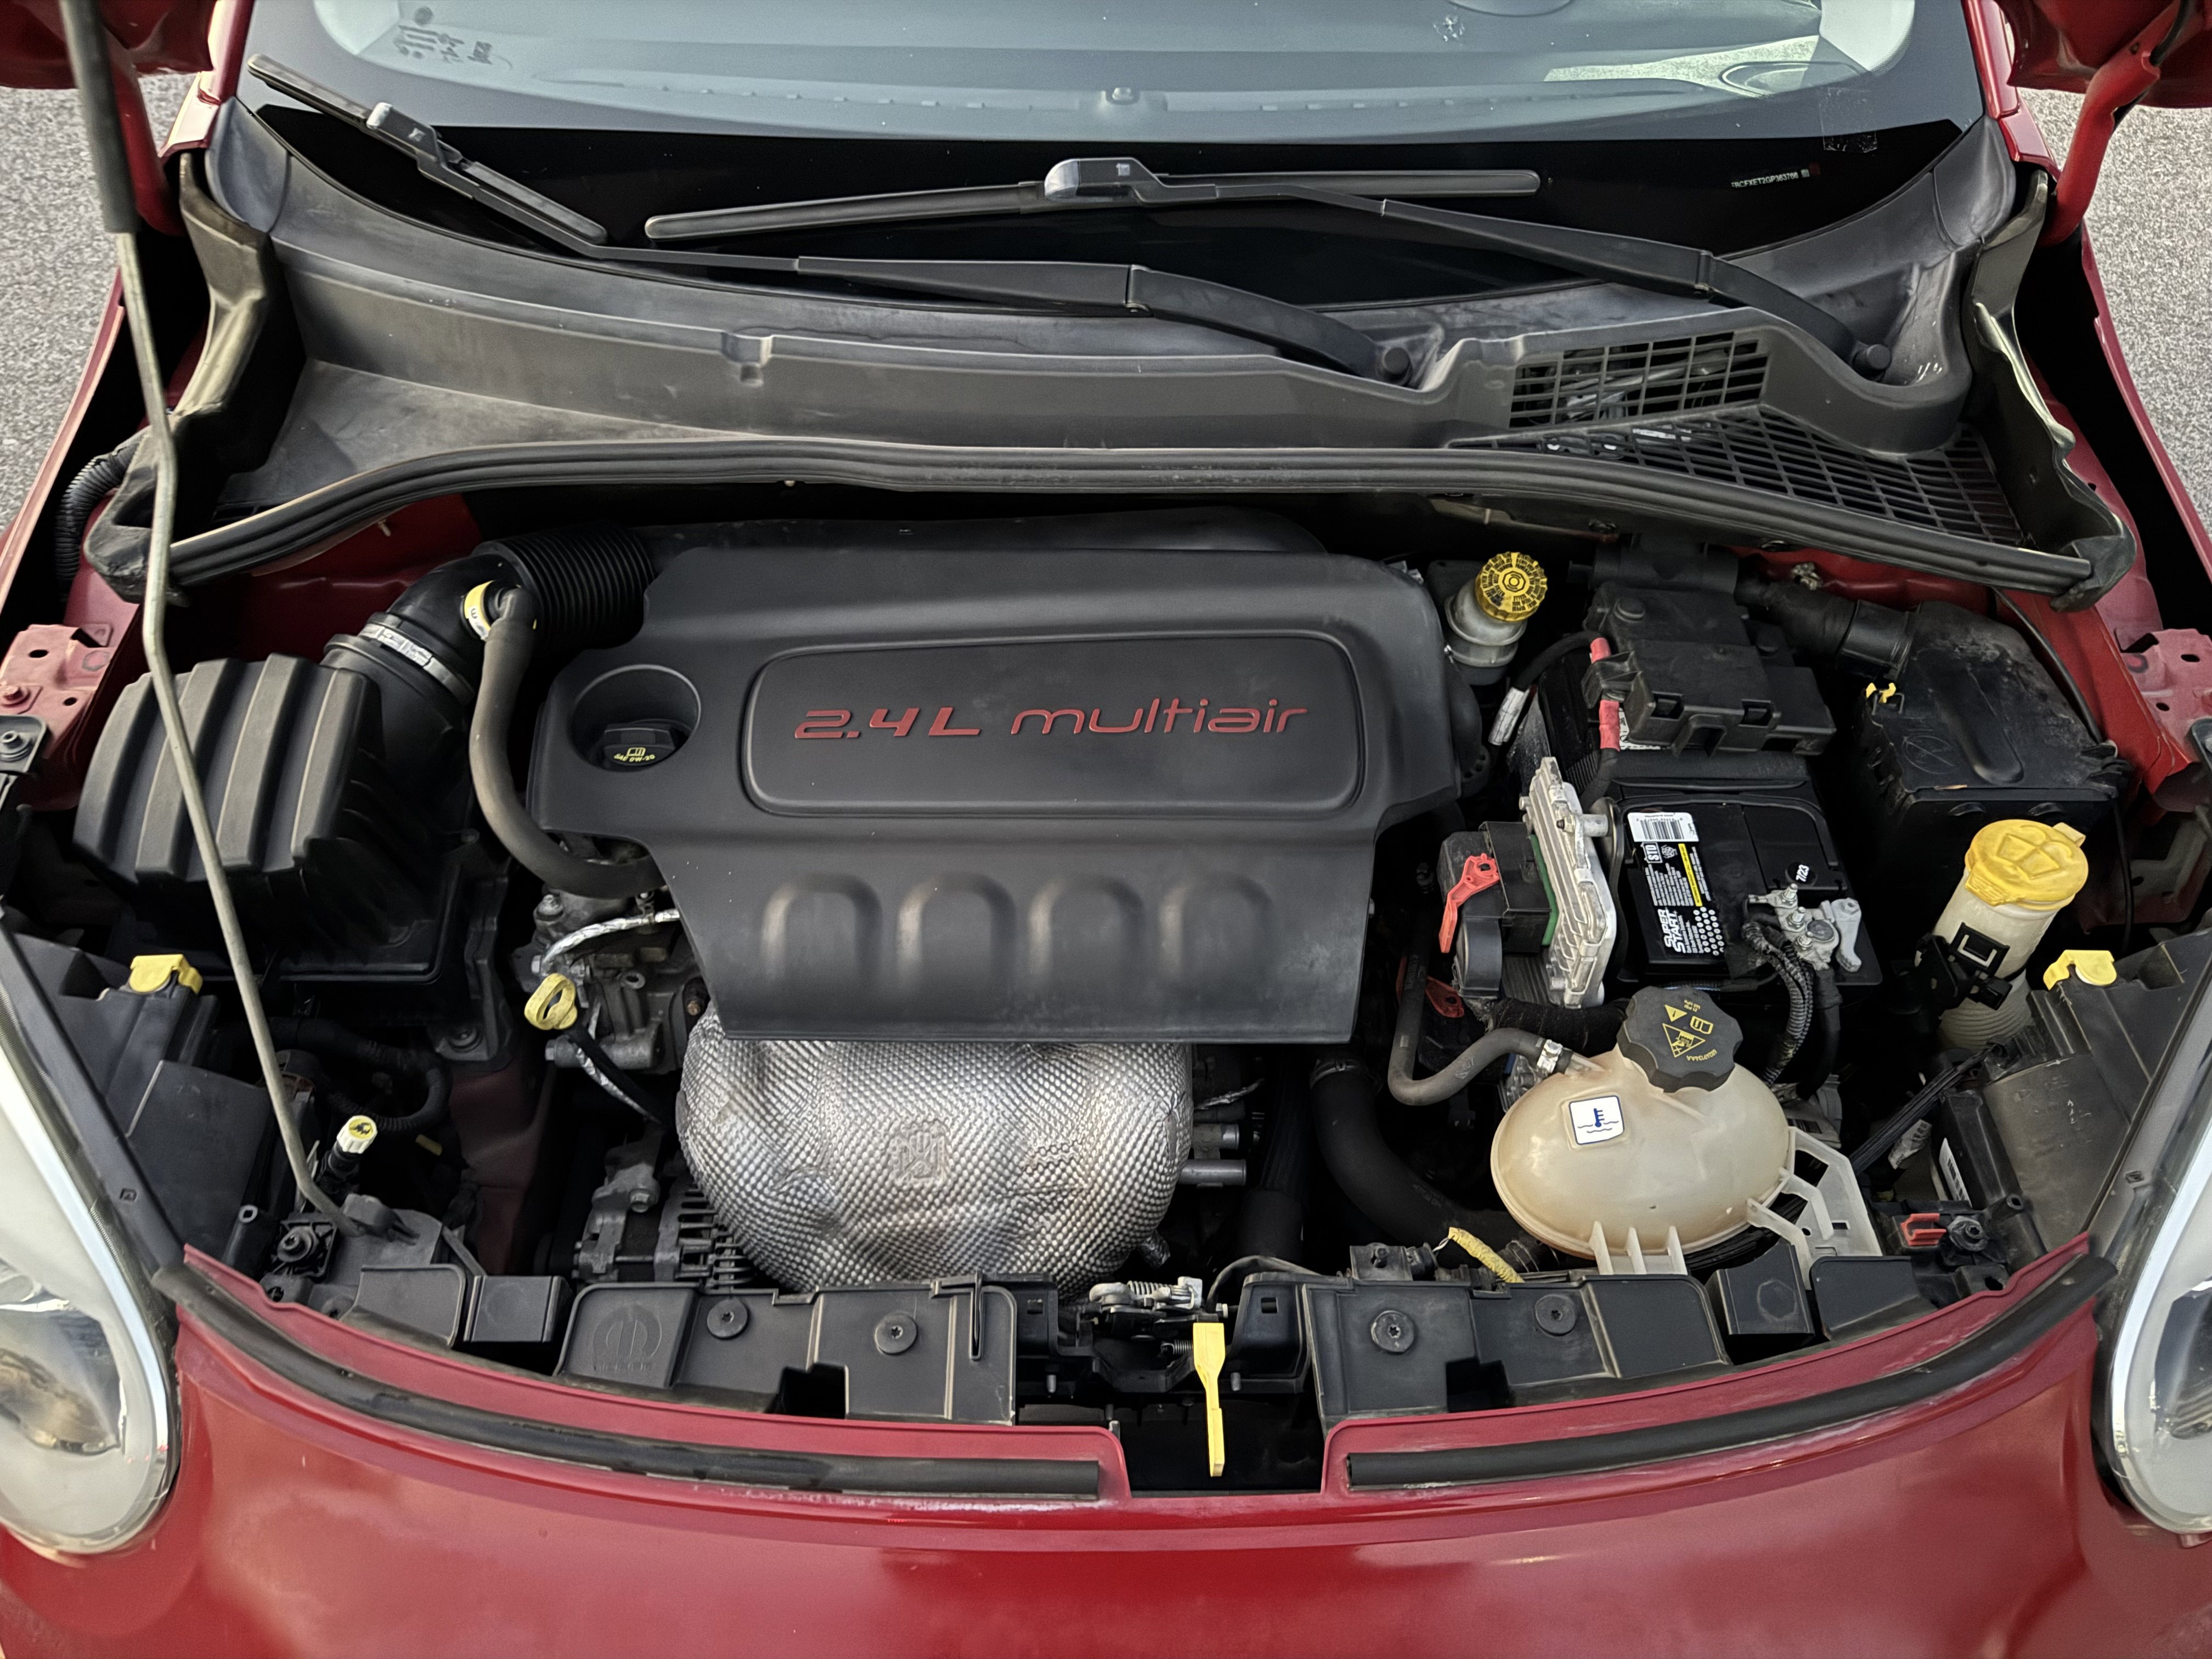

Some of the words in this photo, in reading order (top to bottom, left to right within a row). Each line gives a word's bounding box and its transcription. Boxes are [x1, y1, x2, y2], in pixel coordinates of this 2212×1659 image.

[1011, 698, 1307, 735] multiair
[1645, 844, 1660, 861] STD
[1796, 865, 1809, 882] 7/23
[1657, 909, 1673, 947] SUPER
[1665, 909, 1686, 953] START
